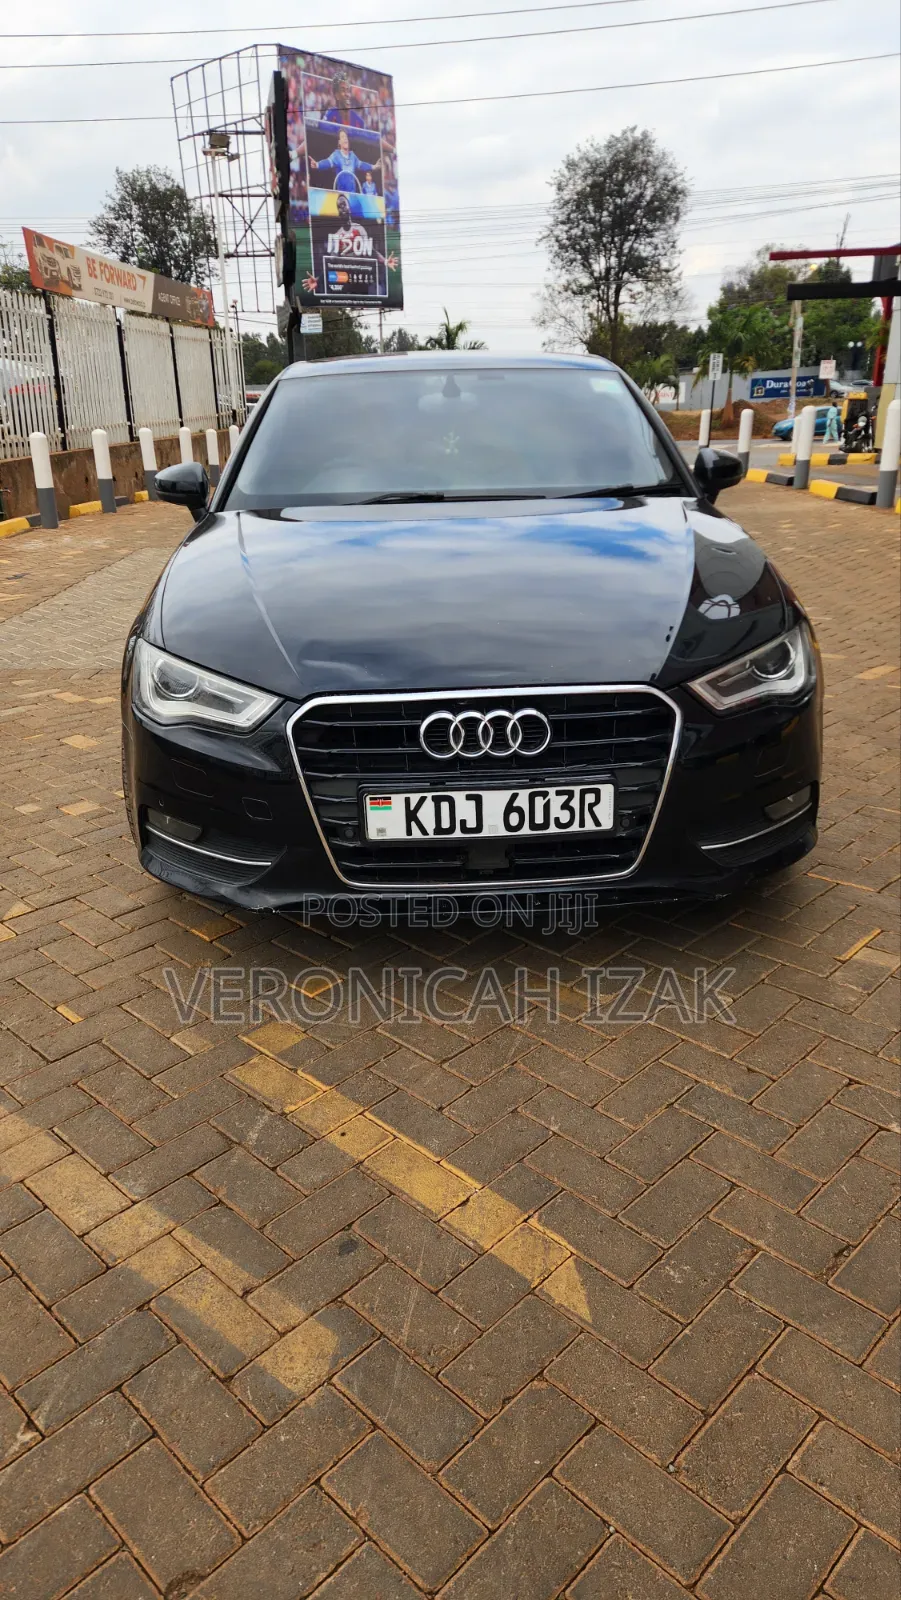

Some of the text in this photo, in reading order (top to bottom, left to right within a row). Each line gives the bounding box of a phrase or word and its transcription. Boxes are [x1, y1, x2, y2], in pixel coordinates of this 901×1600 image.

[353, 235, 373, 257] ON
[86, 256, 137, 291] BE FORWARD
[766, 379, 808, 389] Duraoa
[404, 793, 483, 836] KDJ
[503, 787, 602, 833] 603R
